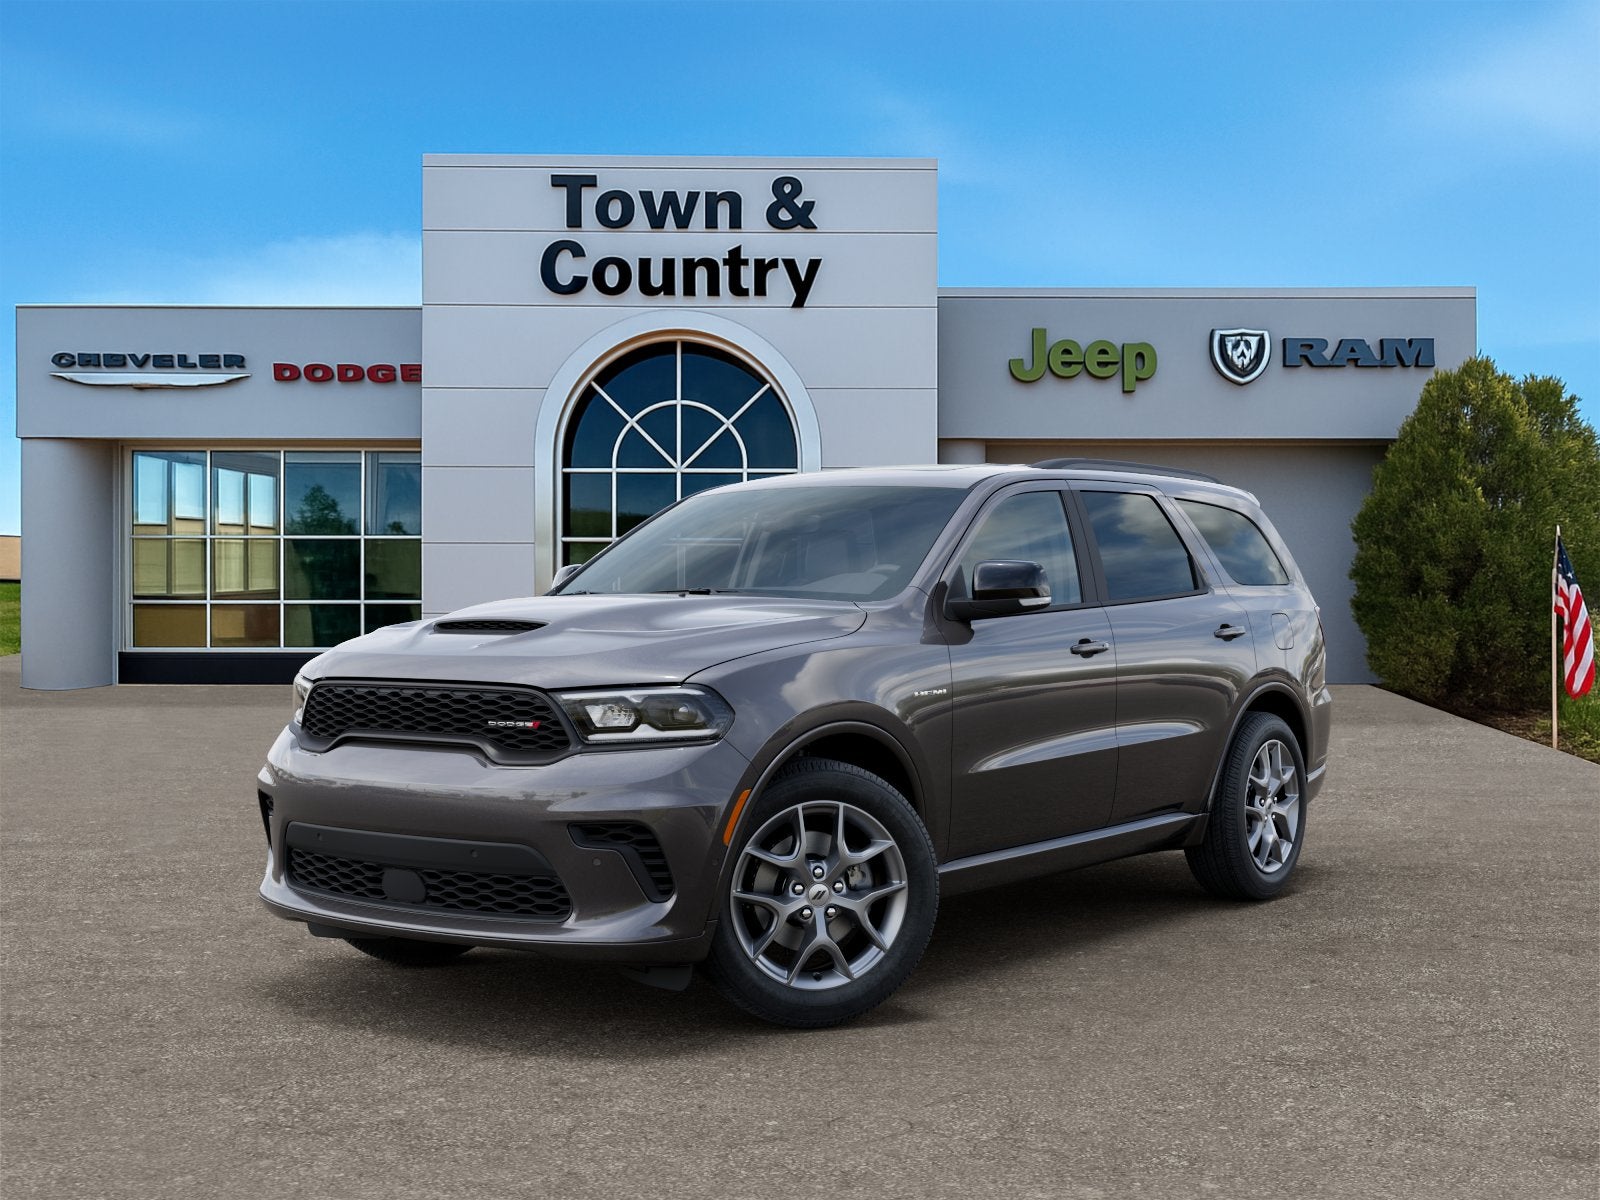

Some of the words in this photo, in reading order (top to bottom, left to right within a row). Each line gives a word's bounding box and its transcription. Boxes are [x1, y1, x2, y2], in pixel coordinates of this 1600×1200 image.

[550, 174, 743, 229] Town
[765, 176, 818, 230] &
[540, 239, 823, 308] Country
[273, 363, 422, 383] DODGE
[1009, 328, 1157, 392] Jeep
[1282, 338, 1435, 367] RAM
